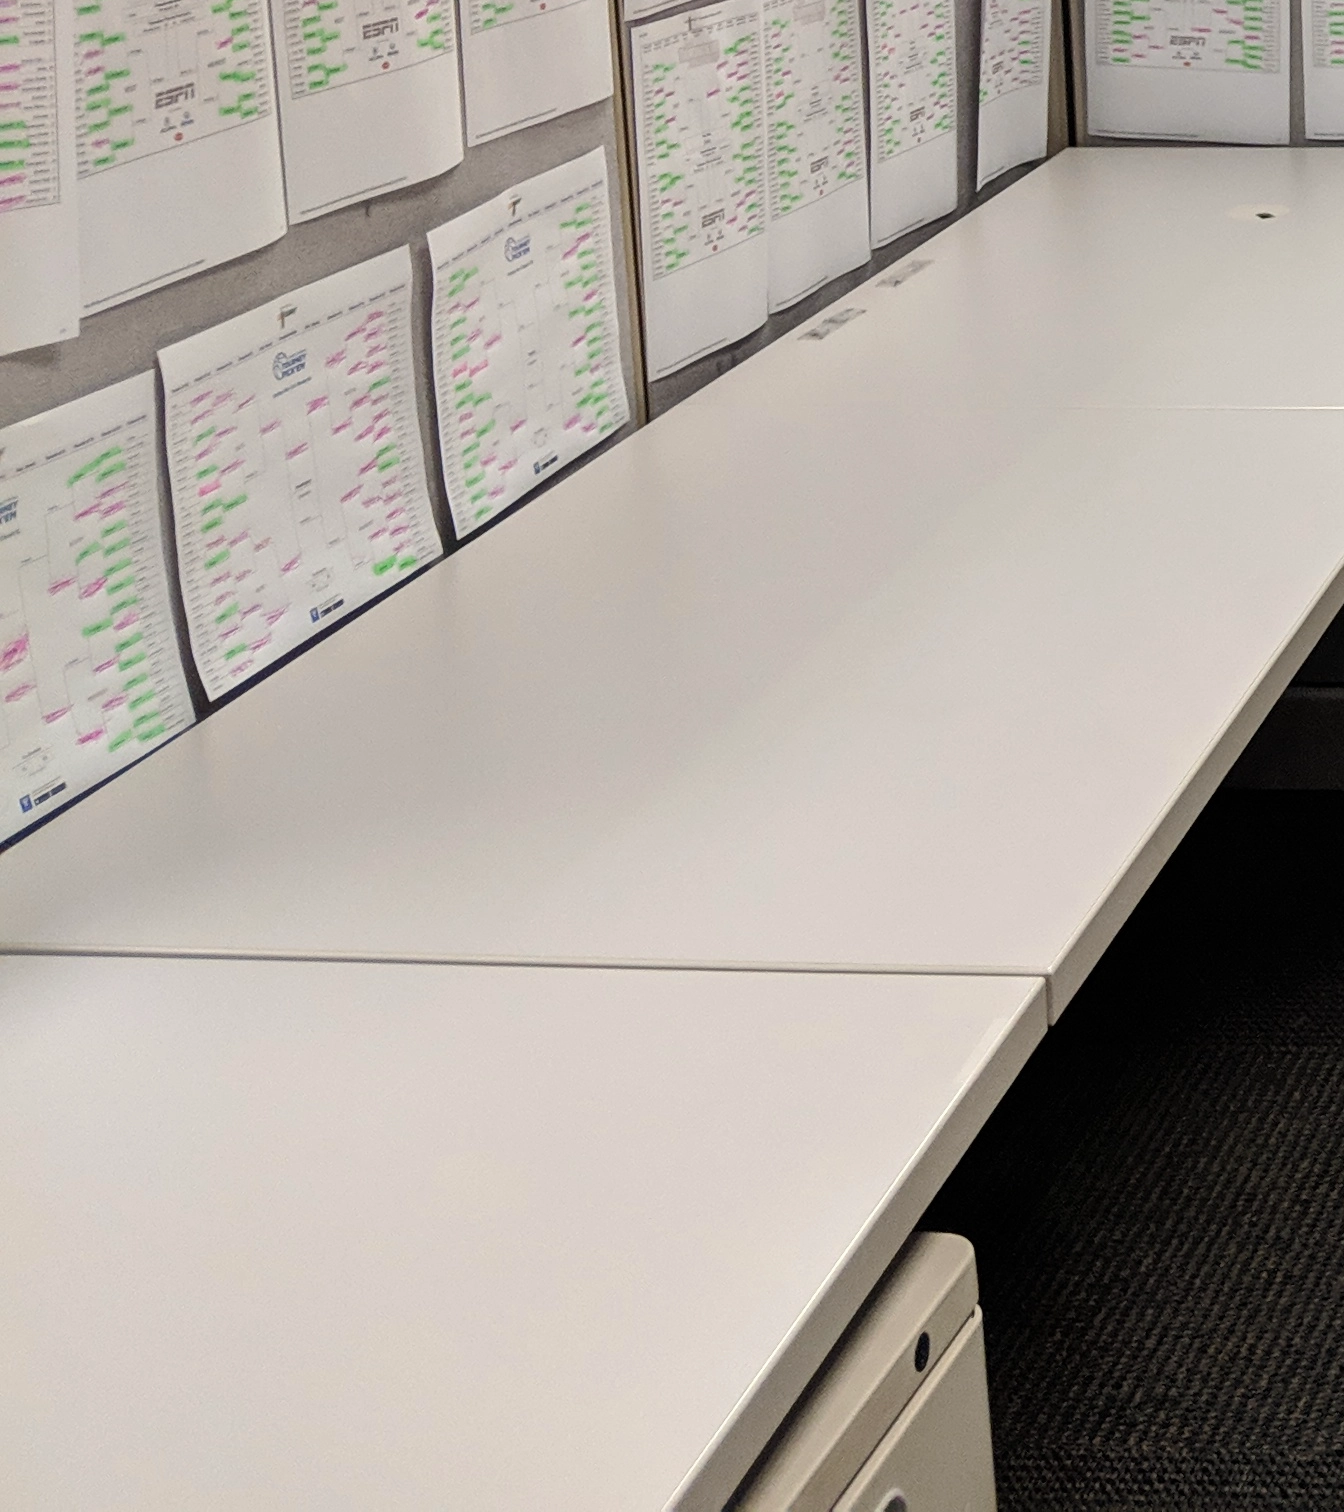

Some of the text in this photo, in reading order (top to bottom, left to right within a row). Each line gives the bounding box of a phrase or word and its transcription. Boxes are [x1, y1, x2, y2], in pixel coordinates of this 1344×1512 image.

[362, 17, 399, 40] ESPN
[1170, 35, 1206, 46] ESPN
[155, 82, 195, 110] ESPN
